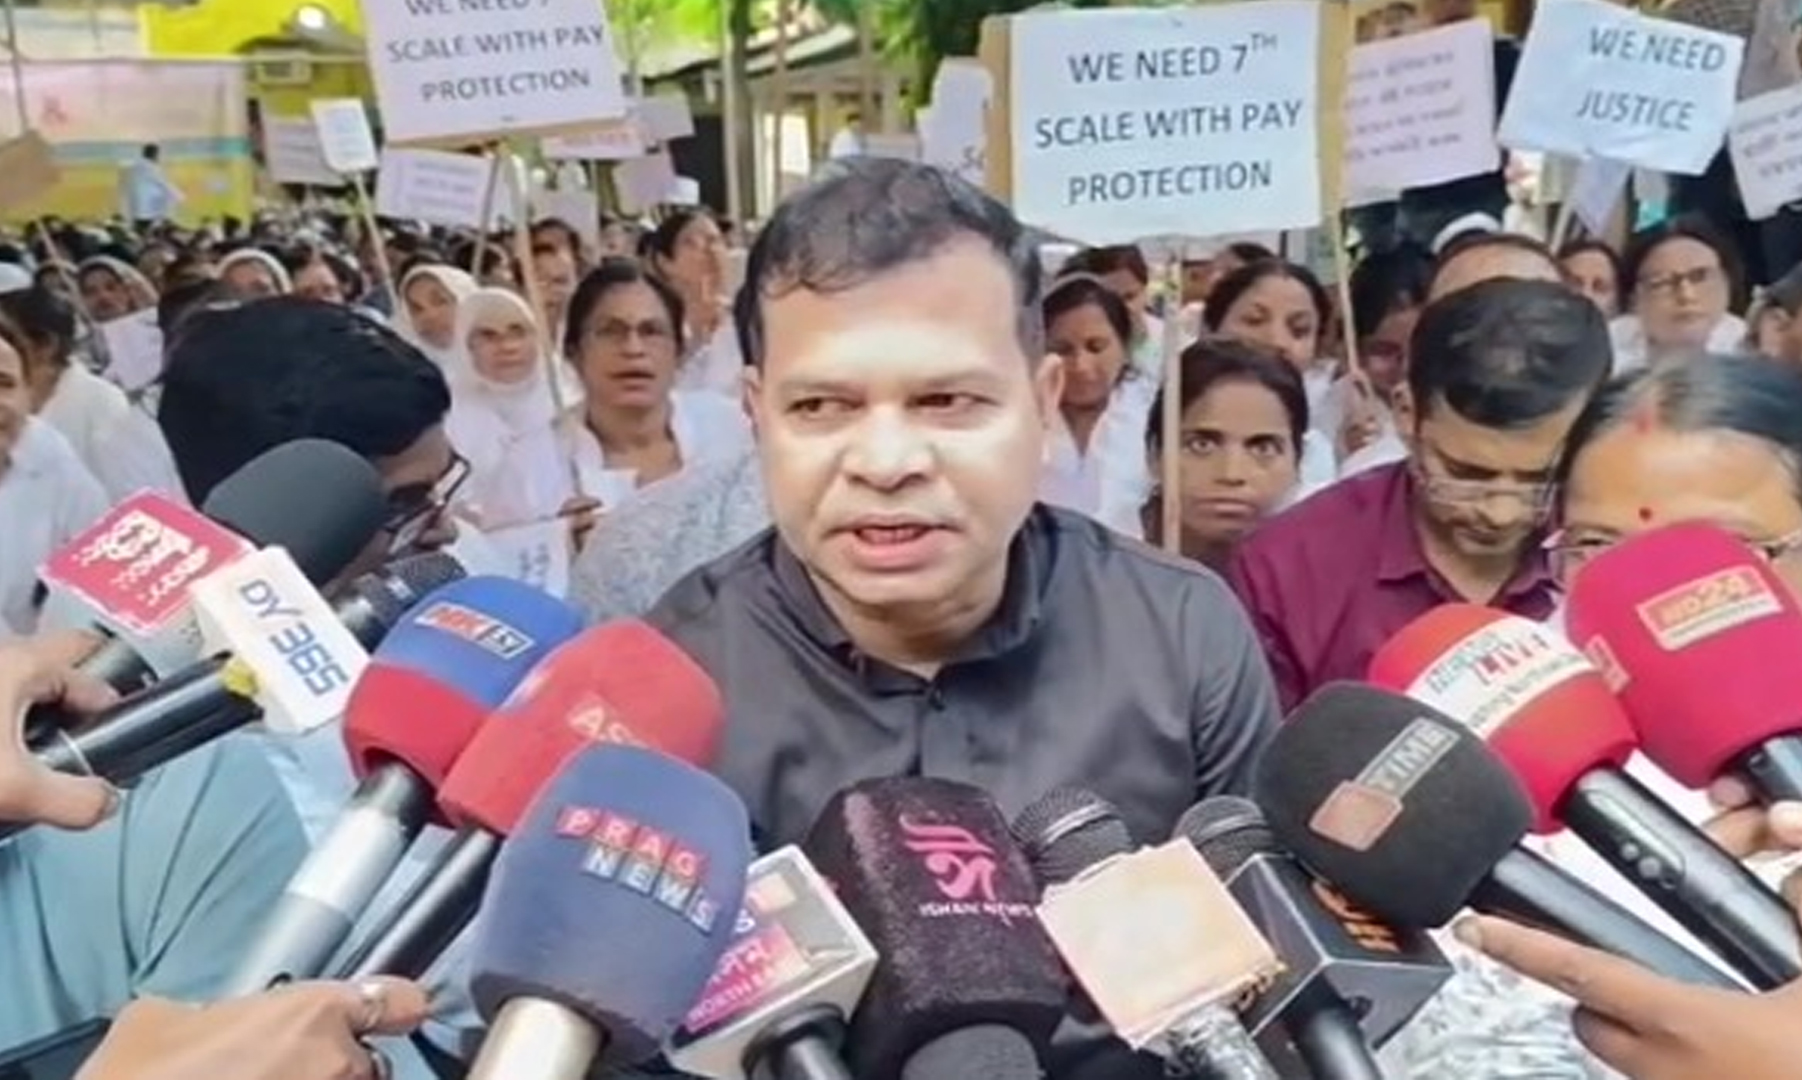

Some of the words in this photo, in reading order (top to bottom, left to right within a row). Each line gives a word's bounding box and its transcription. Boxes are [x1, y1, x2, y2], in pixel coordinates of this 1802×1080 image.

[388, 35, 467, 63] SCALE
[475, 30, 547, 54] WITH
[554, 25, 604, 47] PAY
[1068, 53, 1124, 84] WE
[1136, 46, 1220, 79] NEED
[1589, 27, 1634, 61] WE
[1645, 36, 1726, 73] NEED
[421, 69, 590, 102] PROTECTION
[1036, 113, 1135, 149] SCALE
[1144, 107, 1231, 139] WITH
[1241, 100, 1302, 132] PAY
[1577, 90, 1696, 131] JUSTICE
[1068, 161, 1272, 204] PROTECTION
[563, 807, 703, 879] PRAG
[586, 847, 717, 930] NEWS
